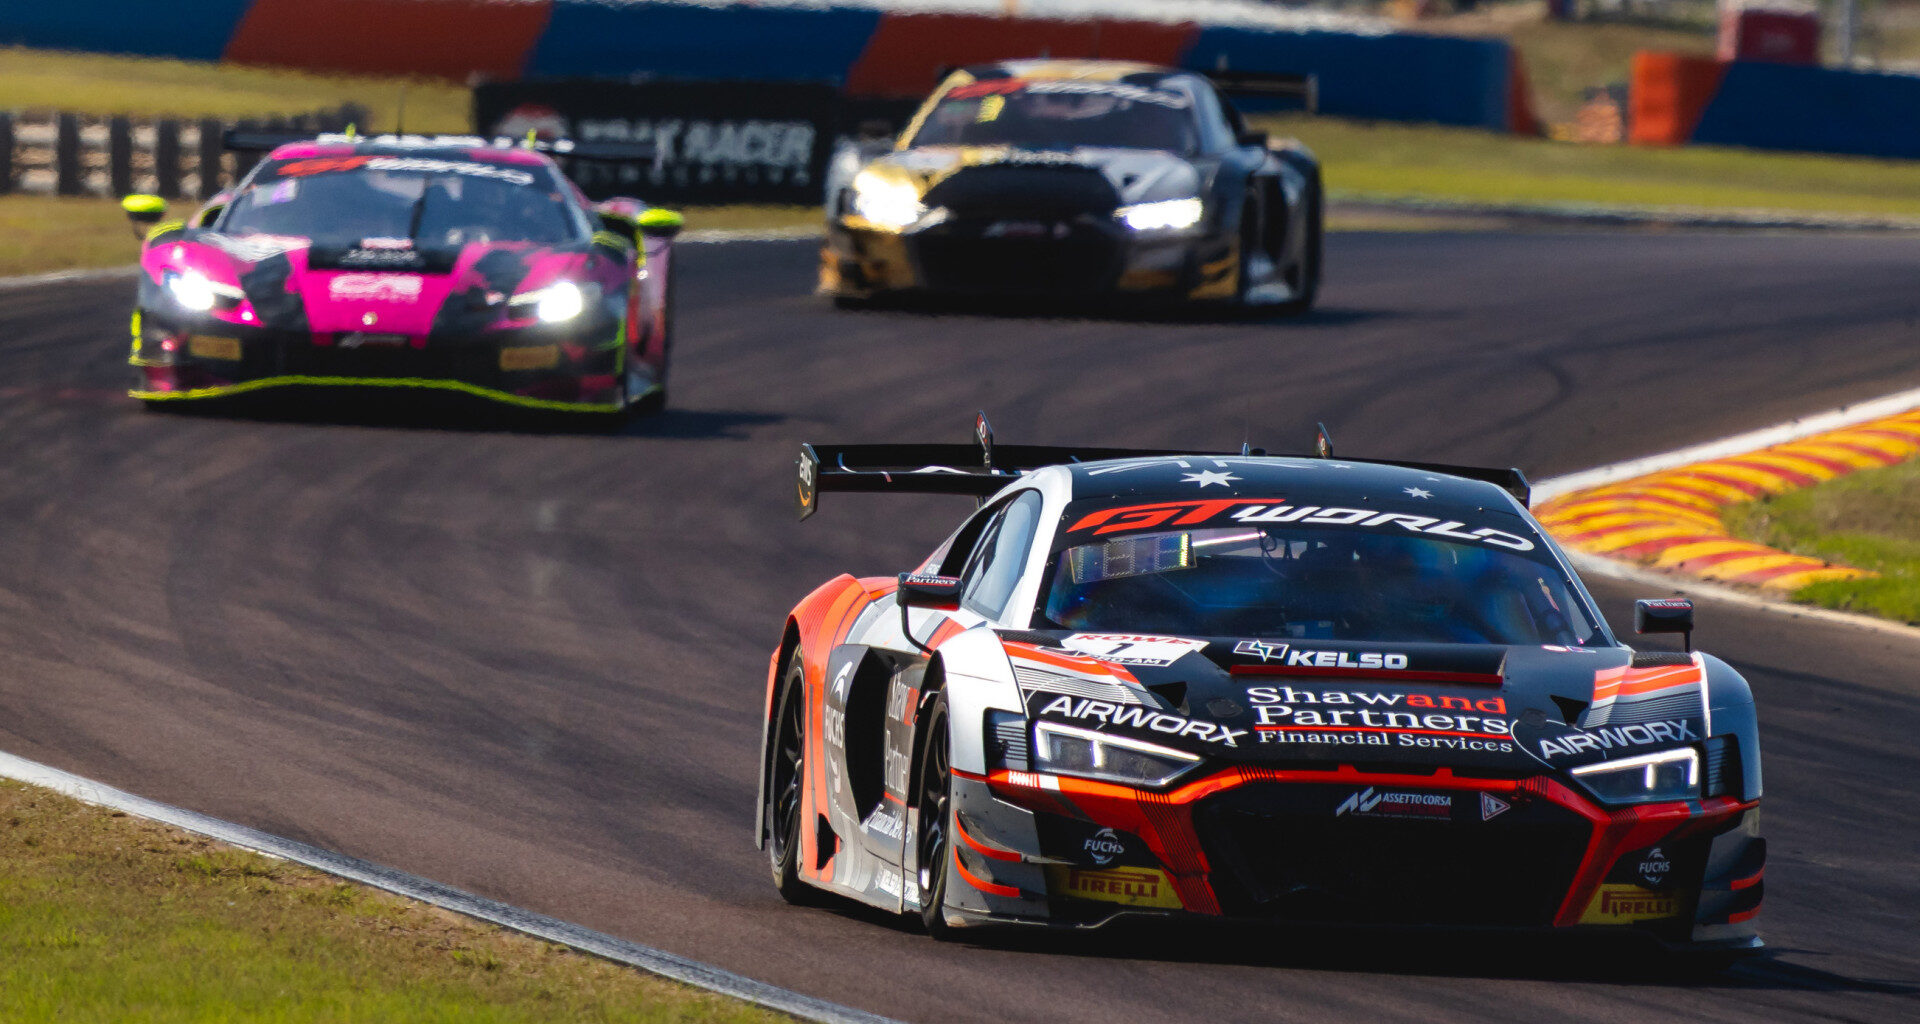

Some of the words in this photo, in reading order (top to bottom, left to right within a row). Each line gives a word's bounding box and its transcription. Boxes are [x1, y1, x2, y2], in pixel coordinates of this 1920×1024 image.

[1106, 643, 1135, 655] 1
[1287, 650, 1408, 670] KELSO
[1041, 696, 1249, 746] AIRWORX
[1252, 705, 1510, 735] Partners
[1259, 730, 1390, 747] Financial
[1399, 733, 1513, 752] Services
[1540, 719, 1698, 759] AIRWORX
[1382, 793, 1423, 805] ASSETTO
[1423, 795, 1451, 806] CORSA
[1084, 839, 1125, 854] FUCHS
[1639, 861, 1670, 873] FUCHS
[1069, 869, 1160, 898] PIRELLI
[1602, 891, 1674, 914] PIRELLI
